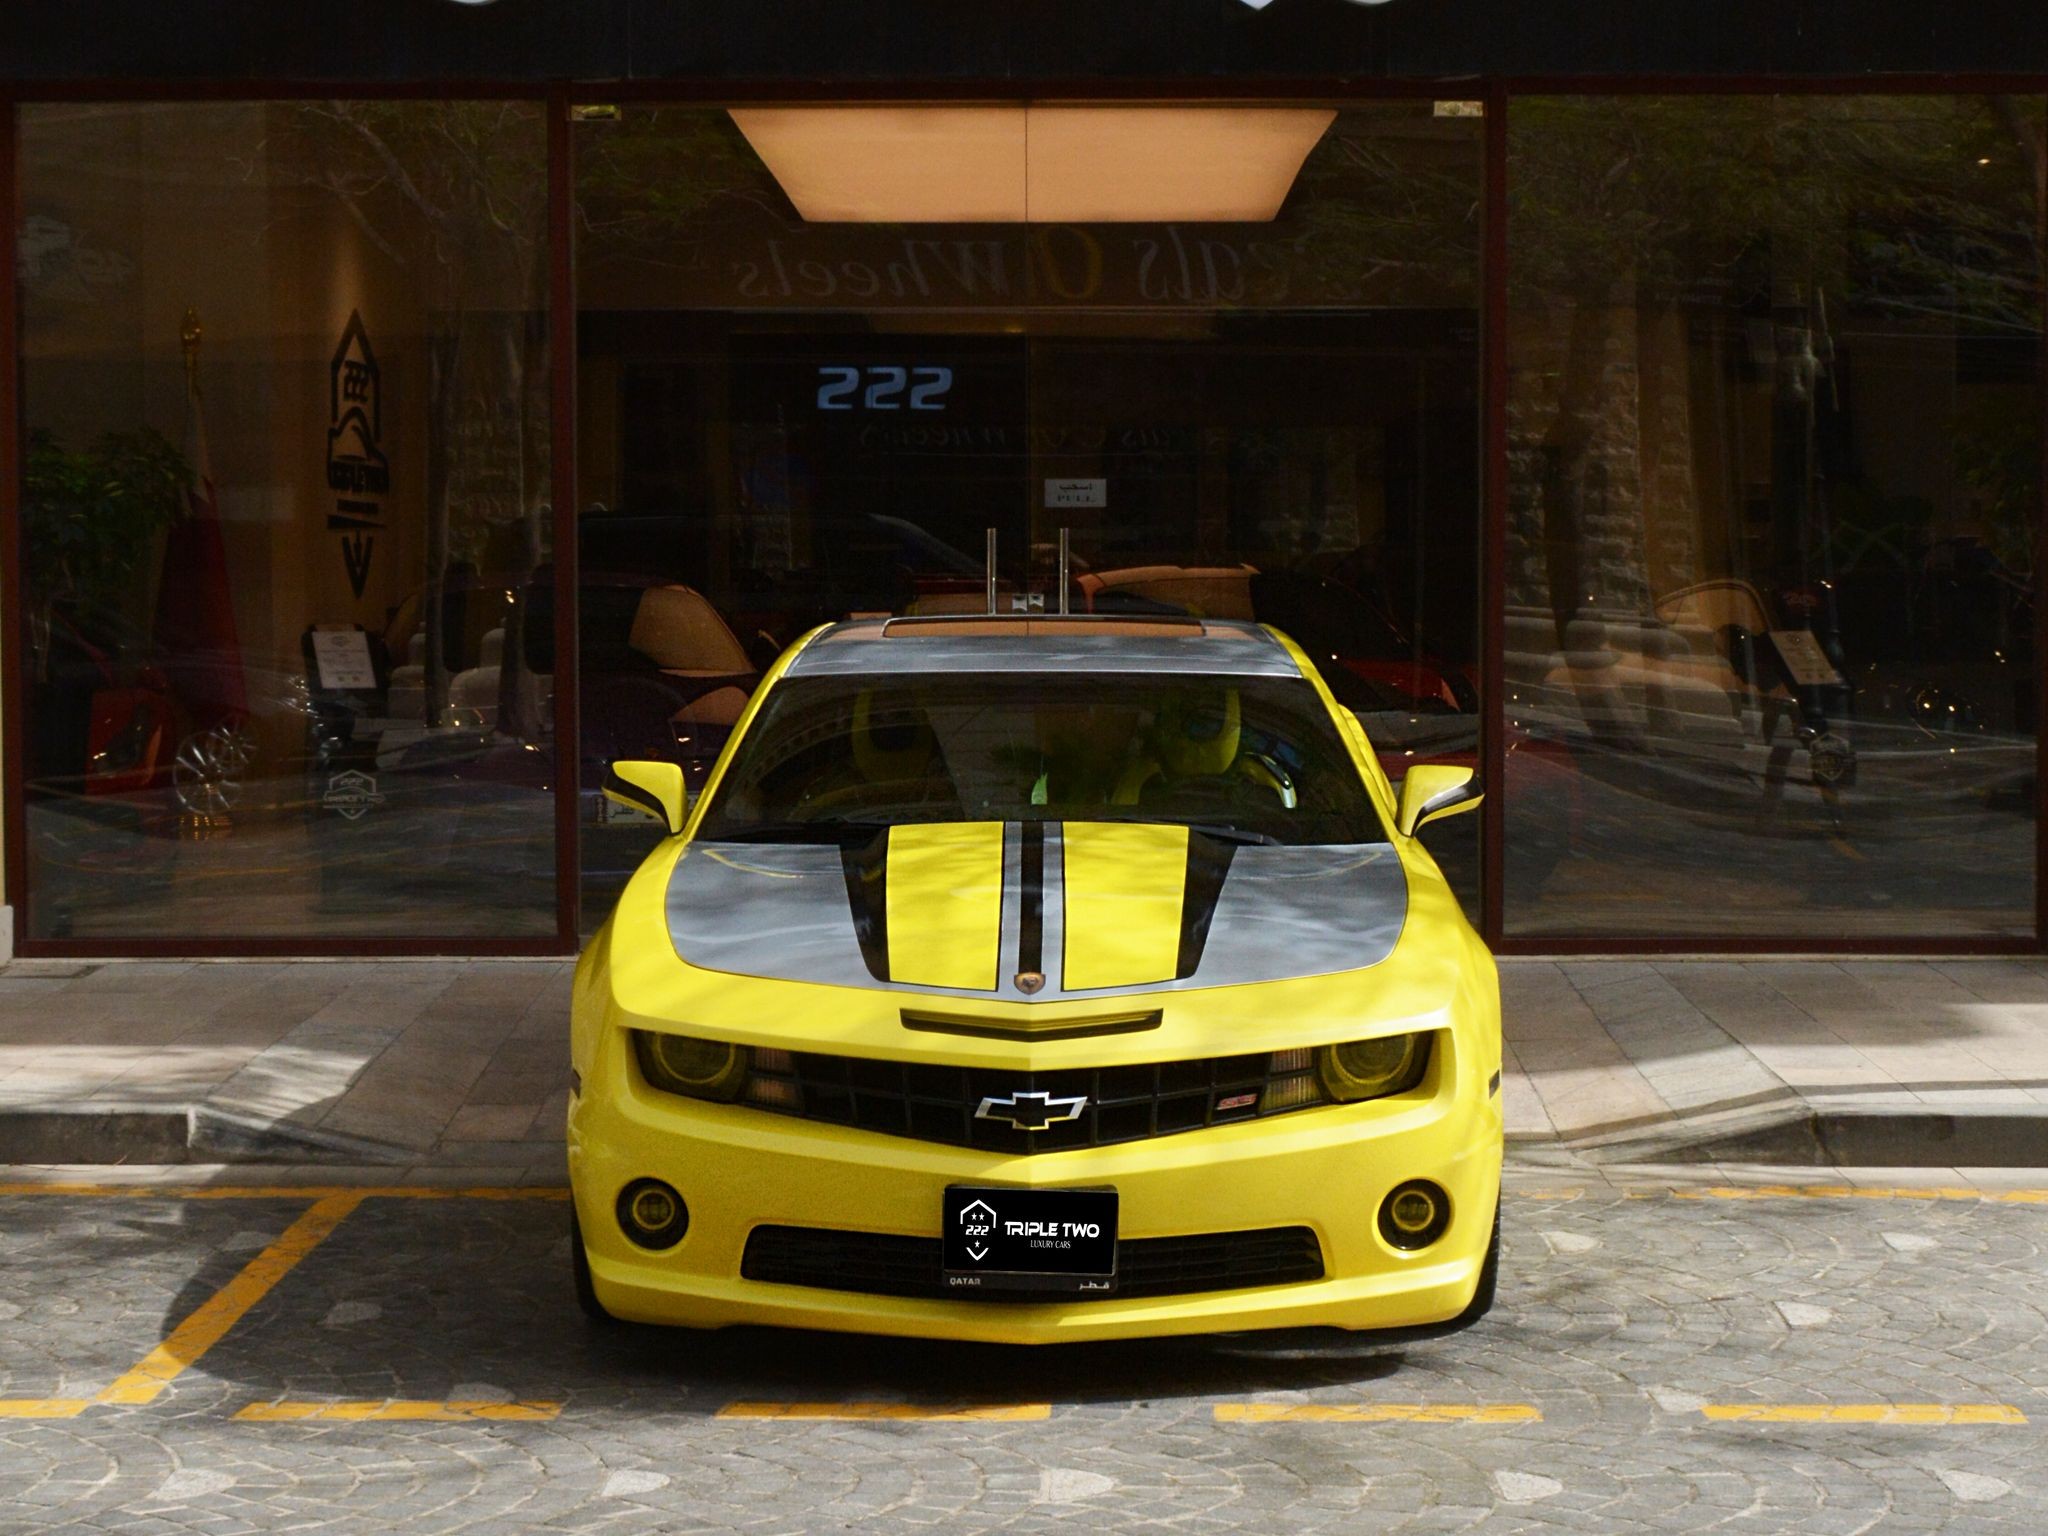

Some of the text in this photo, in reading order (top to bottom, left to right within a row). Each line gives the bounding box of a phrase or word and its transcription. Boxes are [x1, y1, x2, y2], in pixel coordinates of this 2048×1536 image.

[816, 366, 953, 411] 222
[965, 1224, 989, 1236] 222
[1004, 1221, 1101, 1239] TRIPLE TWO
[1030, 1240, 1072, 1250] LUXURY CARS
[949, 1277, 981, 1286] QATAR
[1078, 1281, 1110, 1291] قطر
